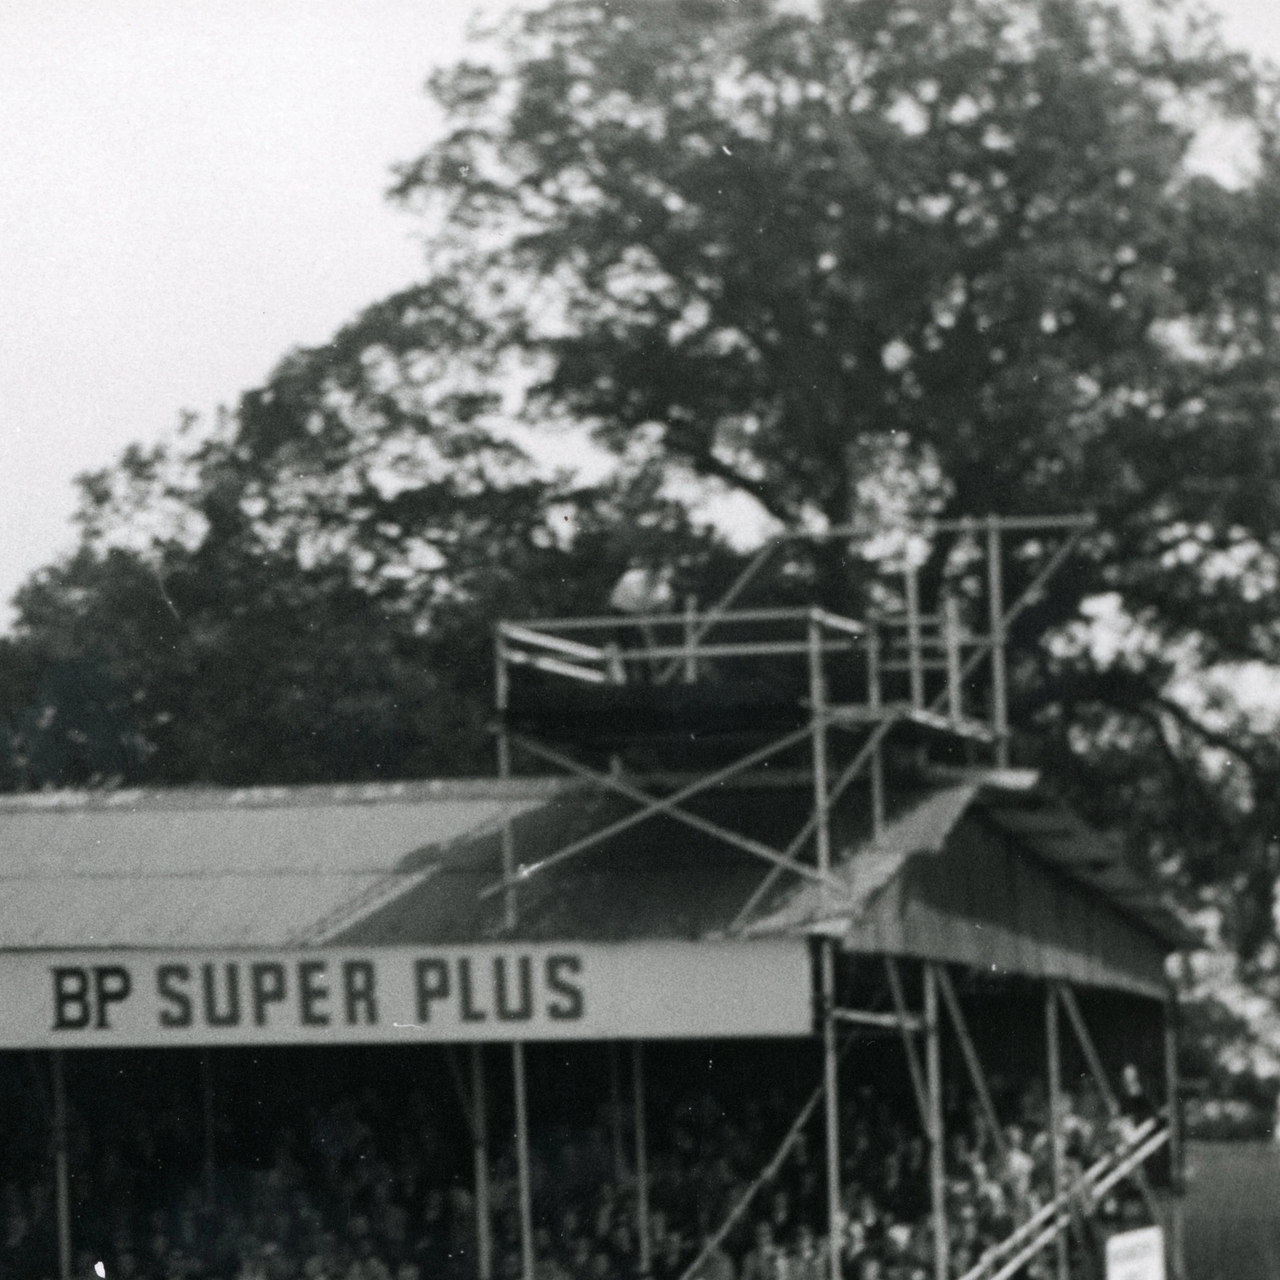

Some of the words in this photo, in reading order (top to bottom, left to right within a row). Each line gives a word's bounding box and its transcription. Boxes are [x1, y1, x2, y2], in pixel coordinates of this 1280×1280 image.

[50, 963, 132, 1031] BP
[155, 959, 377, 1029] SUPER
[415, 953, 584, 1023] PLUS
